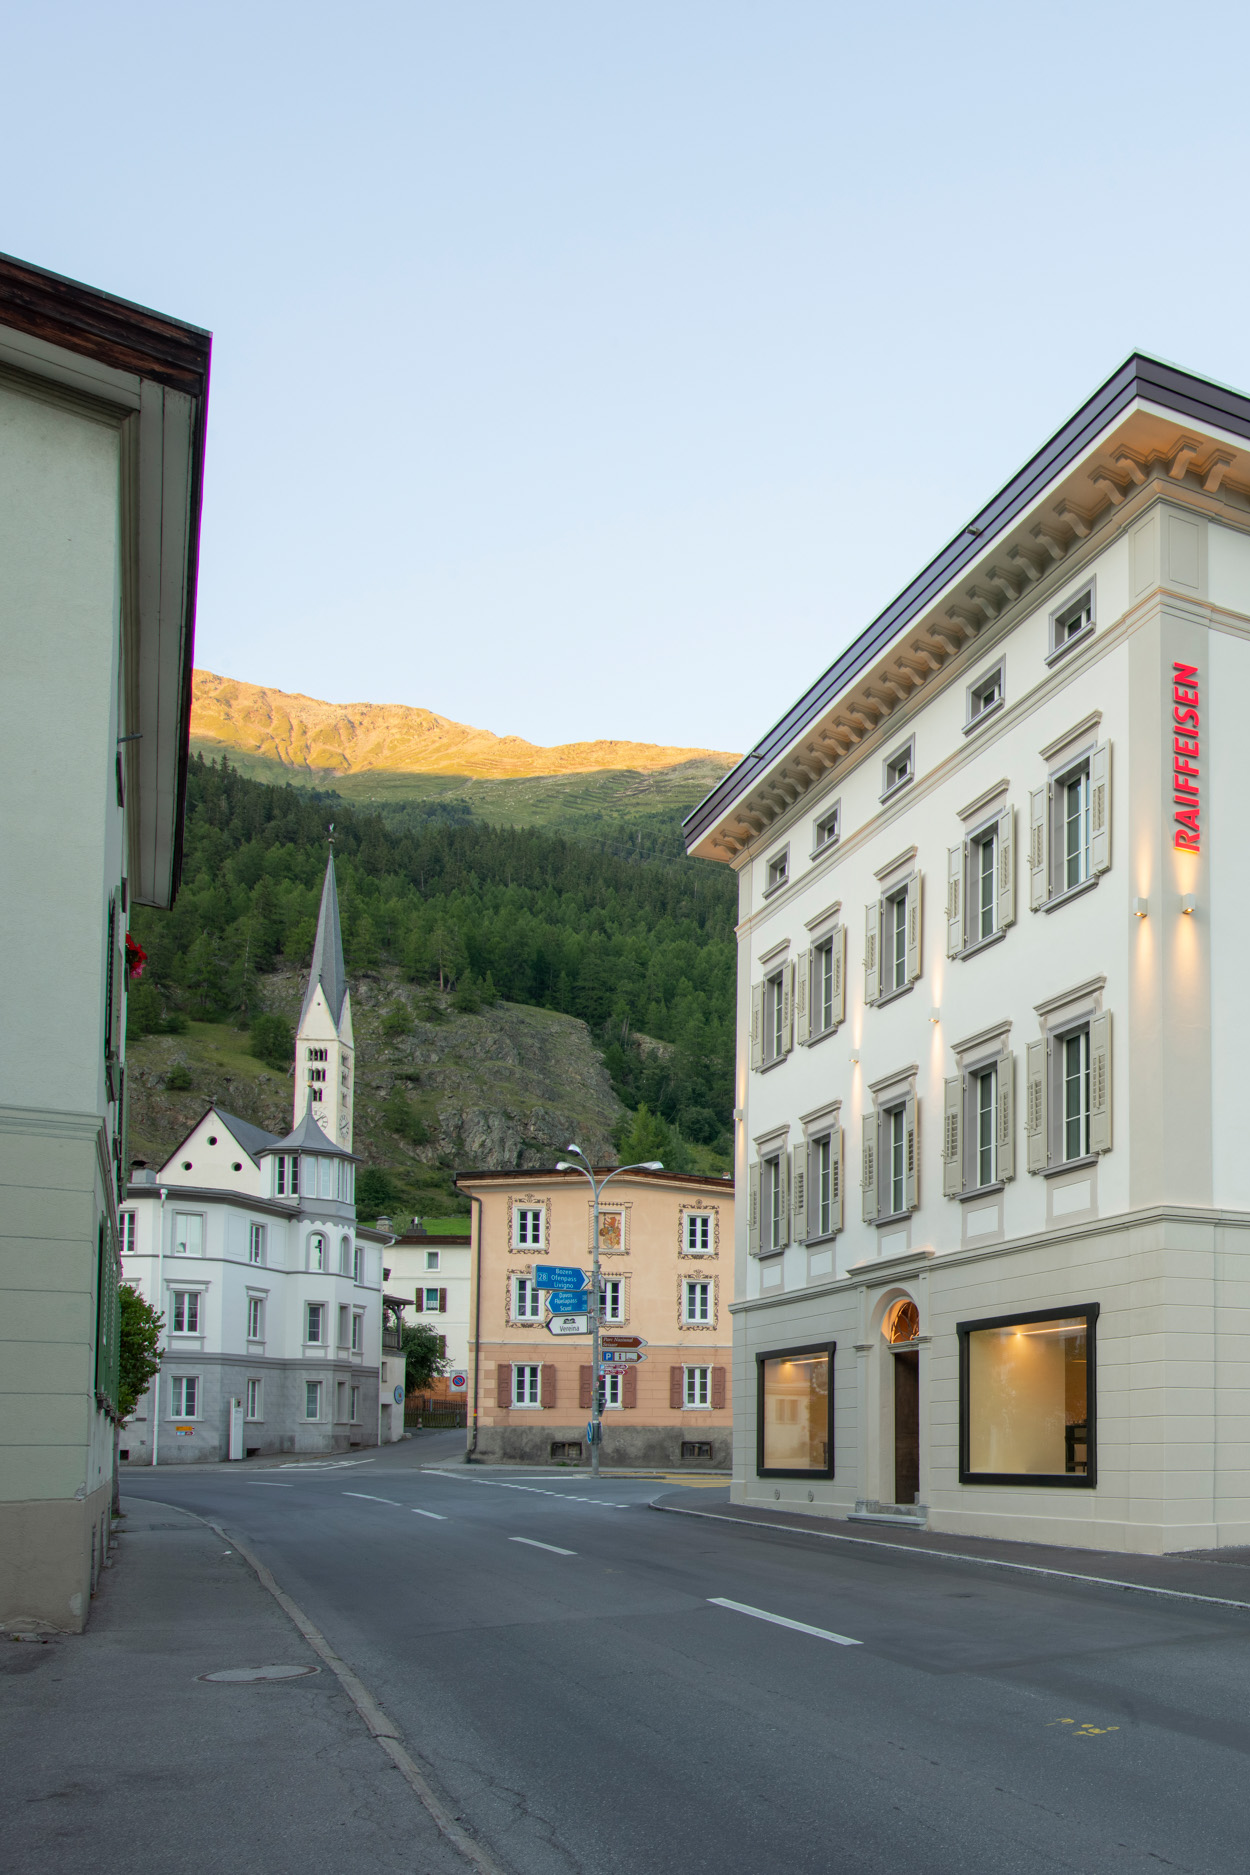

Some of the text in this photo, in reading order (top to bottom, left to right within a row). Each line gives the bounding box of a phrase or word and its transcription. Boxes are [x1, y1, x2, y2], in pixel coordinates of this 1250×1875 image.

[1173, 661, 1200, 854] RAIFFEISEN
[551, 1274, 577, 1282] Ofenpass
[553, 1281, 574, 1290] Livigno
